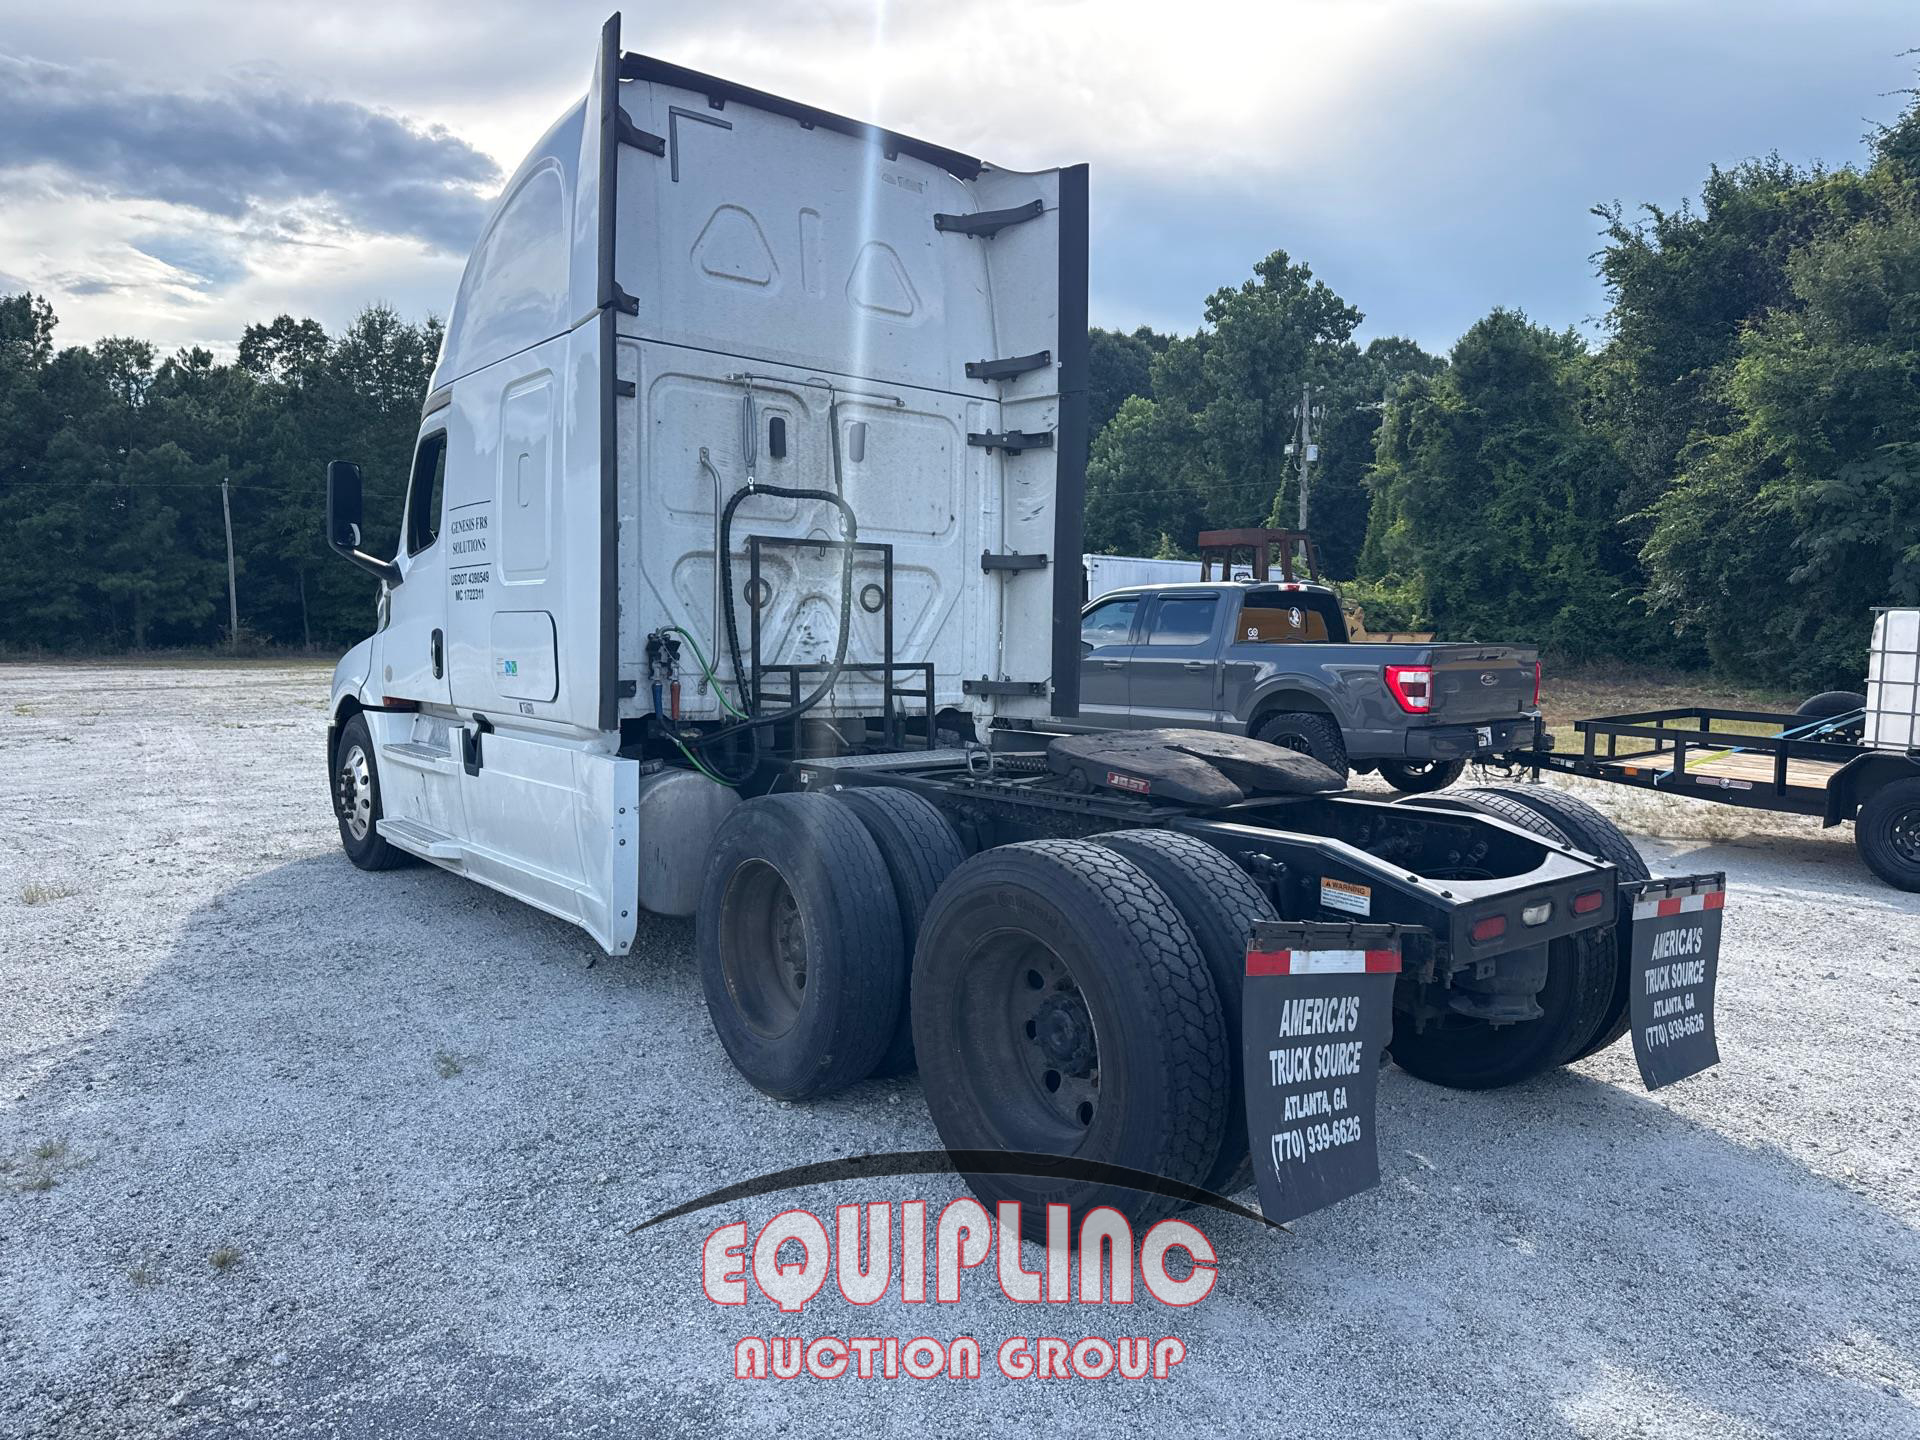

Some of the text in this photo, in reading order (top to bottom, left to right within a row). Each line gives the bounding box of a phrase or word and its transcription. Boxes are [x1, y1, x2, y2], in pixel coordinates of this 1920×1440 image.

[451, 516, 488, 534] GENESIS FR8
[453, 538, 486, 555] SOLUTIONS
[451, 573, 467, 586] USDOT
[455, 589, 463, 601] MC
[1111, 775, 1147, 790] JOST
[1332, 881, 1365, 895] WARNING
[1651, 927, 1703, 960] AMERICA'S
[1645, 959, 1705, 995] TRUCK SOURCE
[1279, 996, 1359, 1037] AMERICA'S
[1653, 992, 1695, 1019] ATLANTA, GA
[1646, 1013, 1704, 1053] (770) 939-6626
[1269, 1041, 1362, 1086] TRUCK SOURCE
[1284, 1087, 1347, 1121] ATLANTA, GA
[1271, 1115, 1361, 1170] (770) 939-6626
